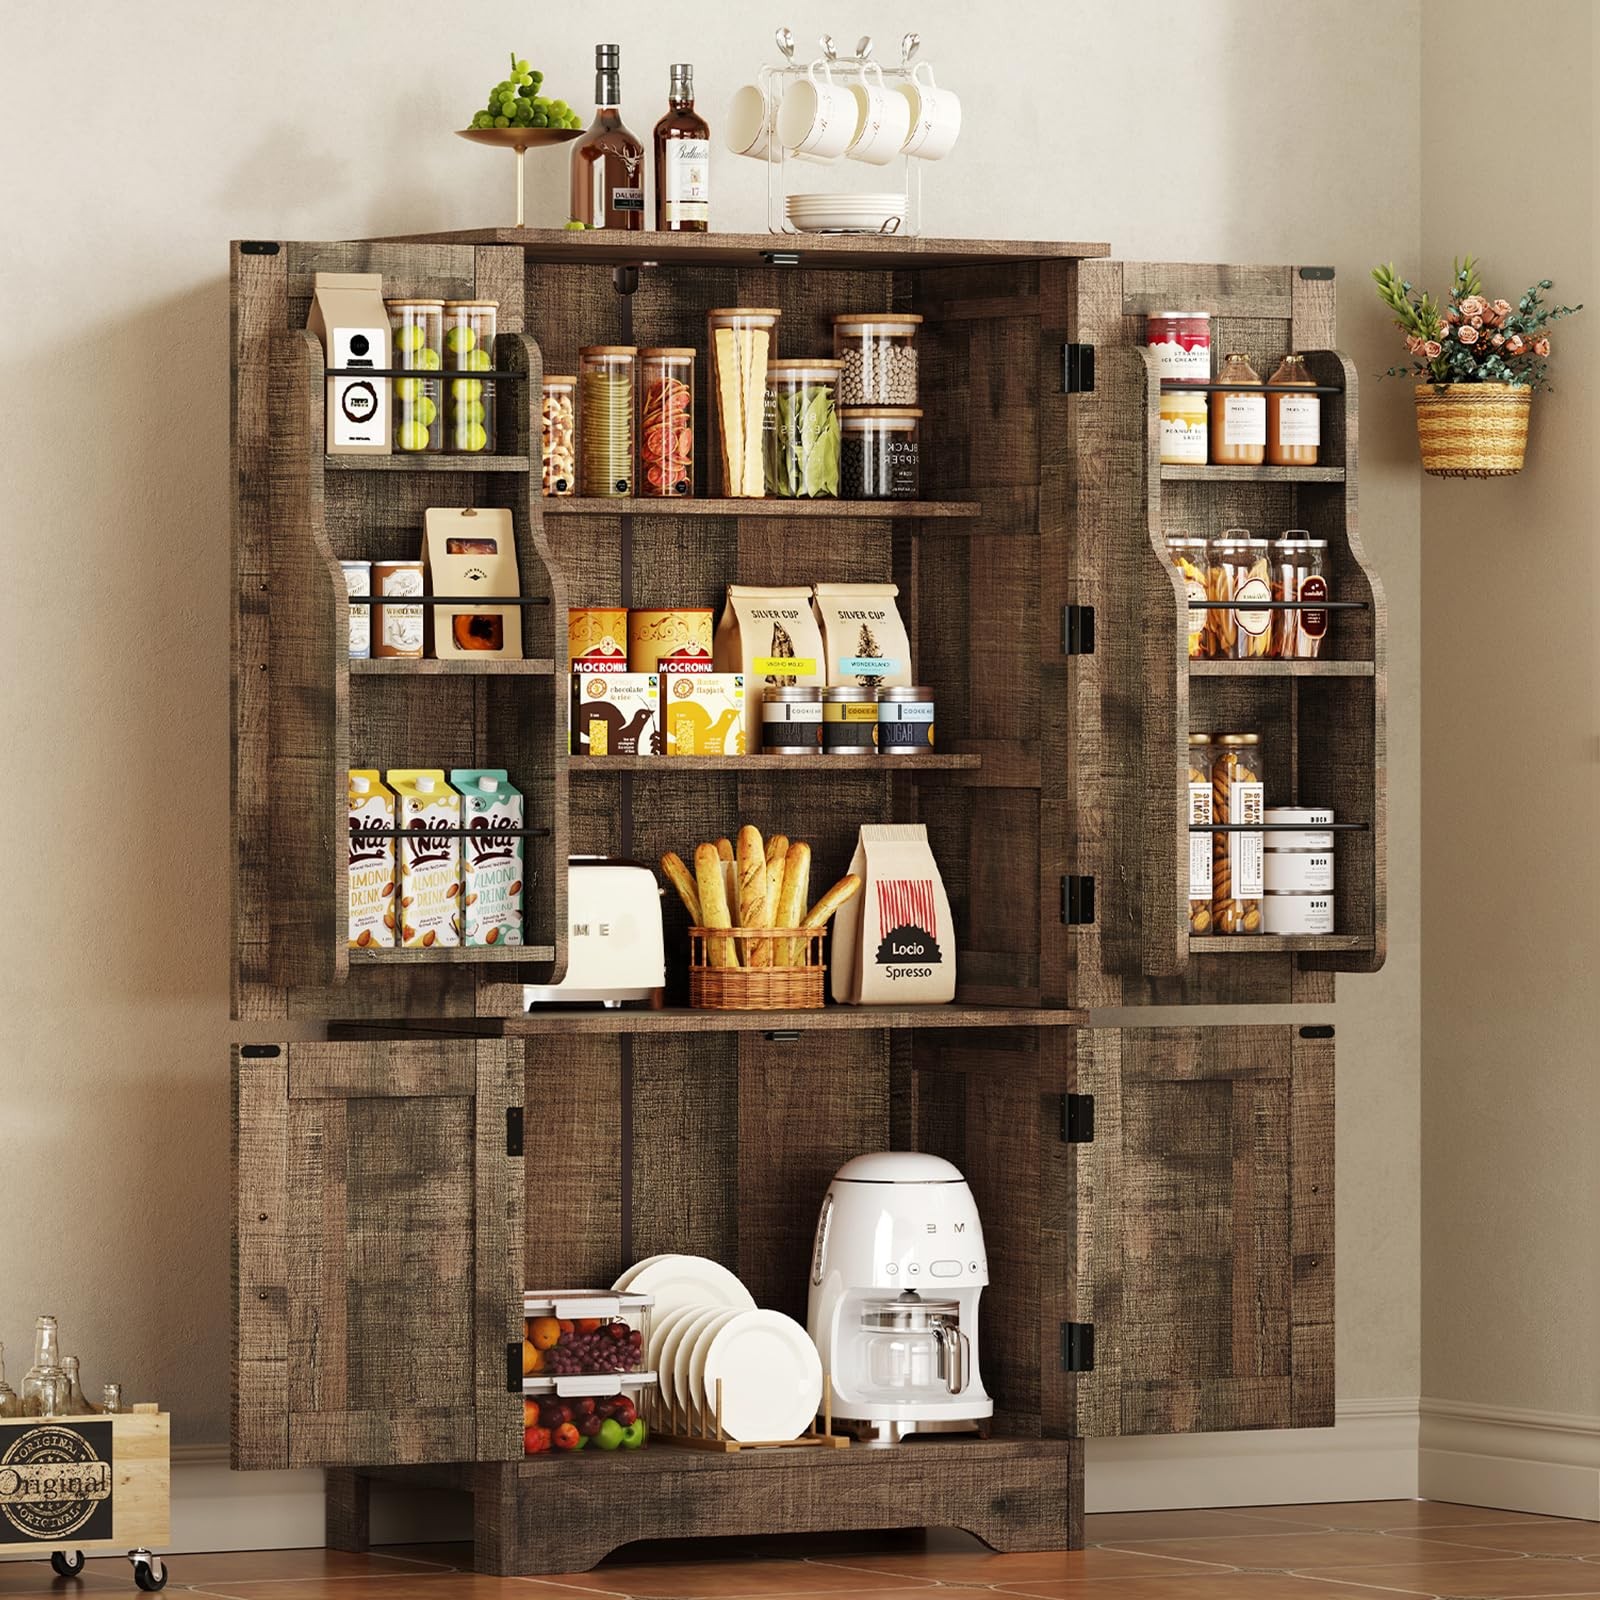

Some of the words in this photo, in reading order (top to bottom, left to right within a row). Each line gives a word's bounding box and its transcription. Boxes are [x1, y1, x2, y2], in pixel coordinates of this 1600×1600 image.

[691, 187, 700, 196] 17
[750, 609, 781, 619] SILVER
[782, 610, 799, 619] CUP
[837, 610, 866, 620] SILVER
[868, 611, 886, 620] CUP
[885, 724, 913, 742] SUGAR
[350, 868, 389, 890] LMOND
[473, 866, 517, 889] ALMOND
[351, 888, 380, 907] DRINK
[416, 888, 446, 906] DRINK
[480, 887, 509, 905] DRINK
[892, 942, 925, 956] Locio
[886, 965, 932, 981] Spresso
[19, 1436, 78, 1458] ORIGINAL
[0, 1465, 107, 1500] Original
[19, 1509, 80, 1528] ORIGINAL
